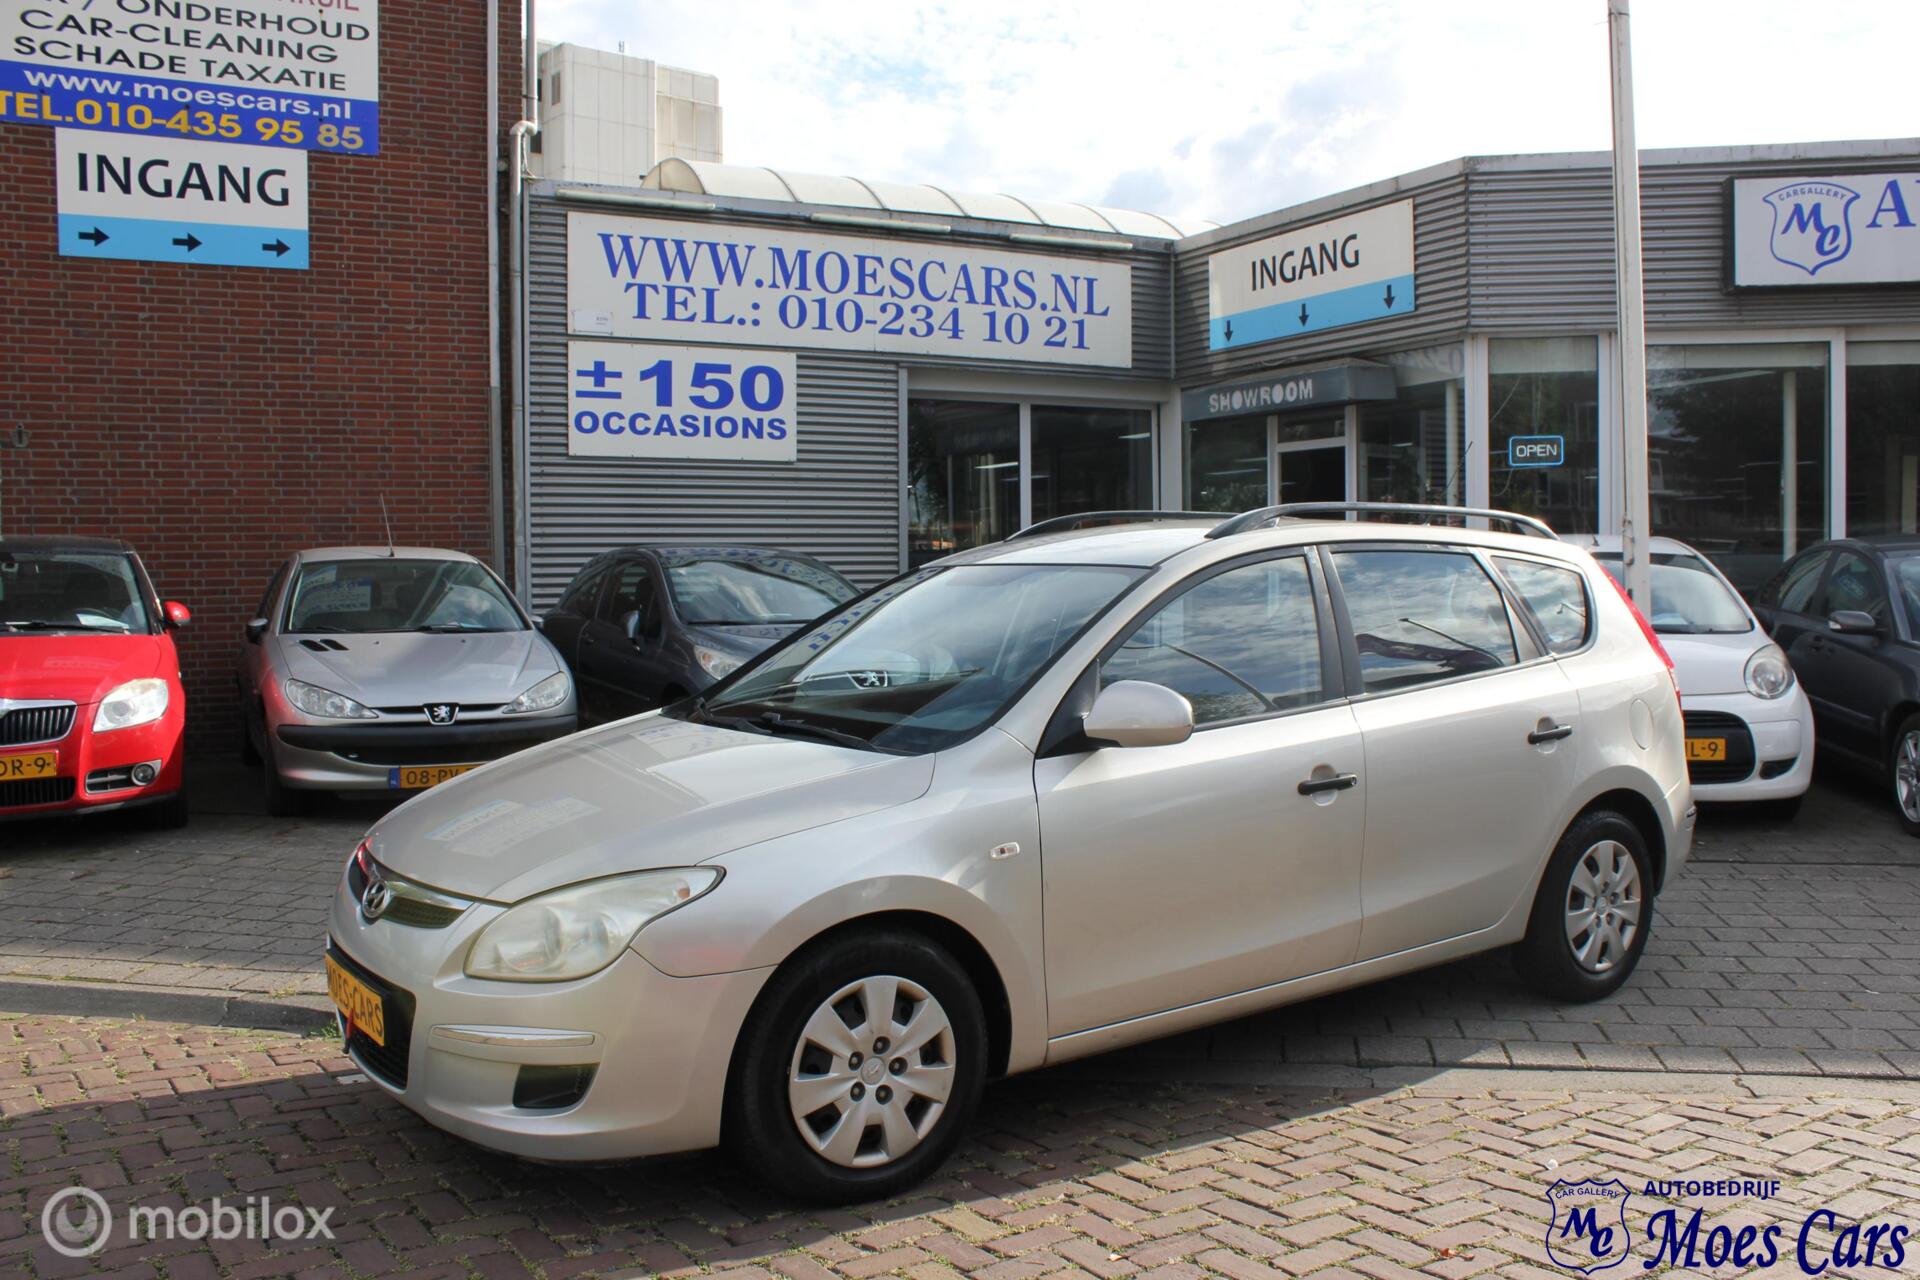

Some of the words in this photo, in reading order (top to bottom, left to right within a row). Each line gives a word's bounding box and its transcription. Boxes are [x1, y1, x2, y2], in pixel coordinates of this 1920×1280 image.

[20, 9, 338, 63] CAR-CLEANING
[116, 0, 369, 40] ONDERHOUD
[14, 36, 187, 74] SCHADE
[200, 58, 346, 91] TAXATIE
[0, 89, 242, 138] TEL.010-435
[256, 118, 303, 144] 95
[317, 124, 363, 150] 85
[24, 70, 350, 119] www.moescars.nl
[77, 152, 289, 207] INGANG
[1865, 179, 1920, 229] A
[598, 233, 1110, 317] WWW.MOESCARS.NL
[1250, 233, 1360, 291] INGANG
[624, 282, 761, 327] TEL.:
[778, 294, 965, 340] 010-234
[982, 312, 1030, 345] 10
[1043, 315, 1090, 350] 21
[1209, 378, 1314, 413] SHOWROOM
[573, 410, 787, 440] OCCASIONS
[1516, 443, 1558, 457] OPEN
[1685, 741, 1719, 758] L-9
[406, 767, 476, 785] 08-PV
